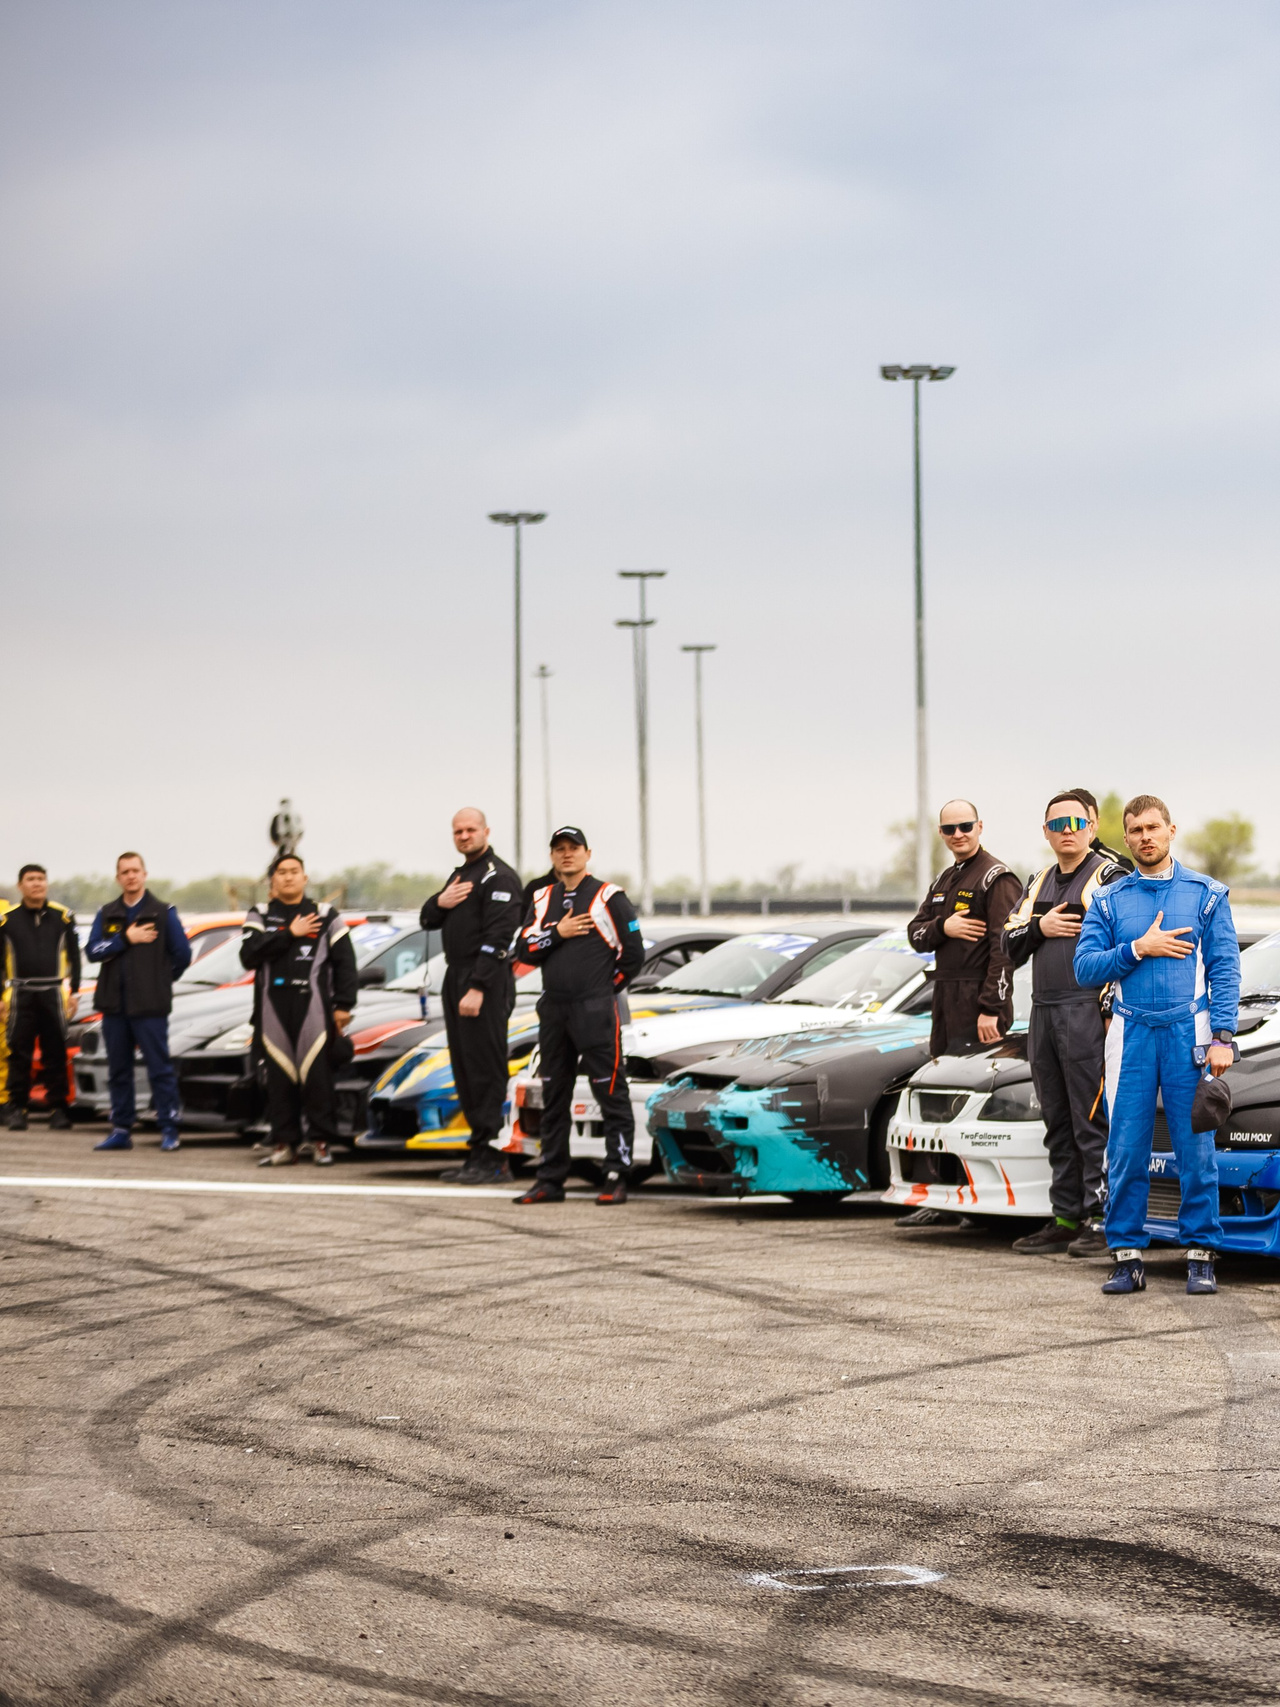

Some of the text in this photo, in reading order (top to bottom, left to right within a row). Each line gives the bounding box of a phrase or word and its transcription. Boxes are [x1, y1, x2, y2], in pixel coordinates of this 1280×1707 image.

[960, 1131, 1012, 1141] TwoFollowers
[1229, 1132, 1273, 1143] LIQUI MOLY
[1148, 1157, 1167, 1174] APY
